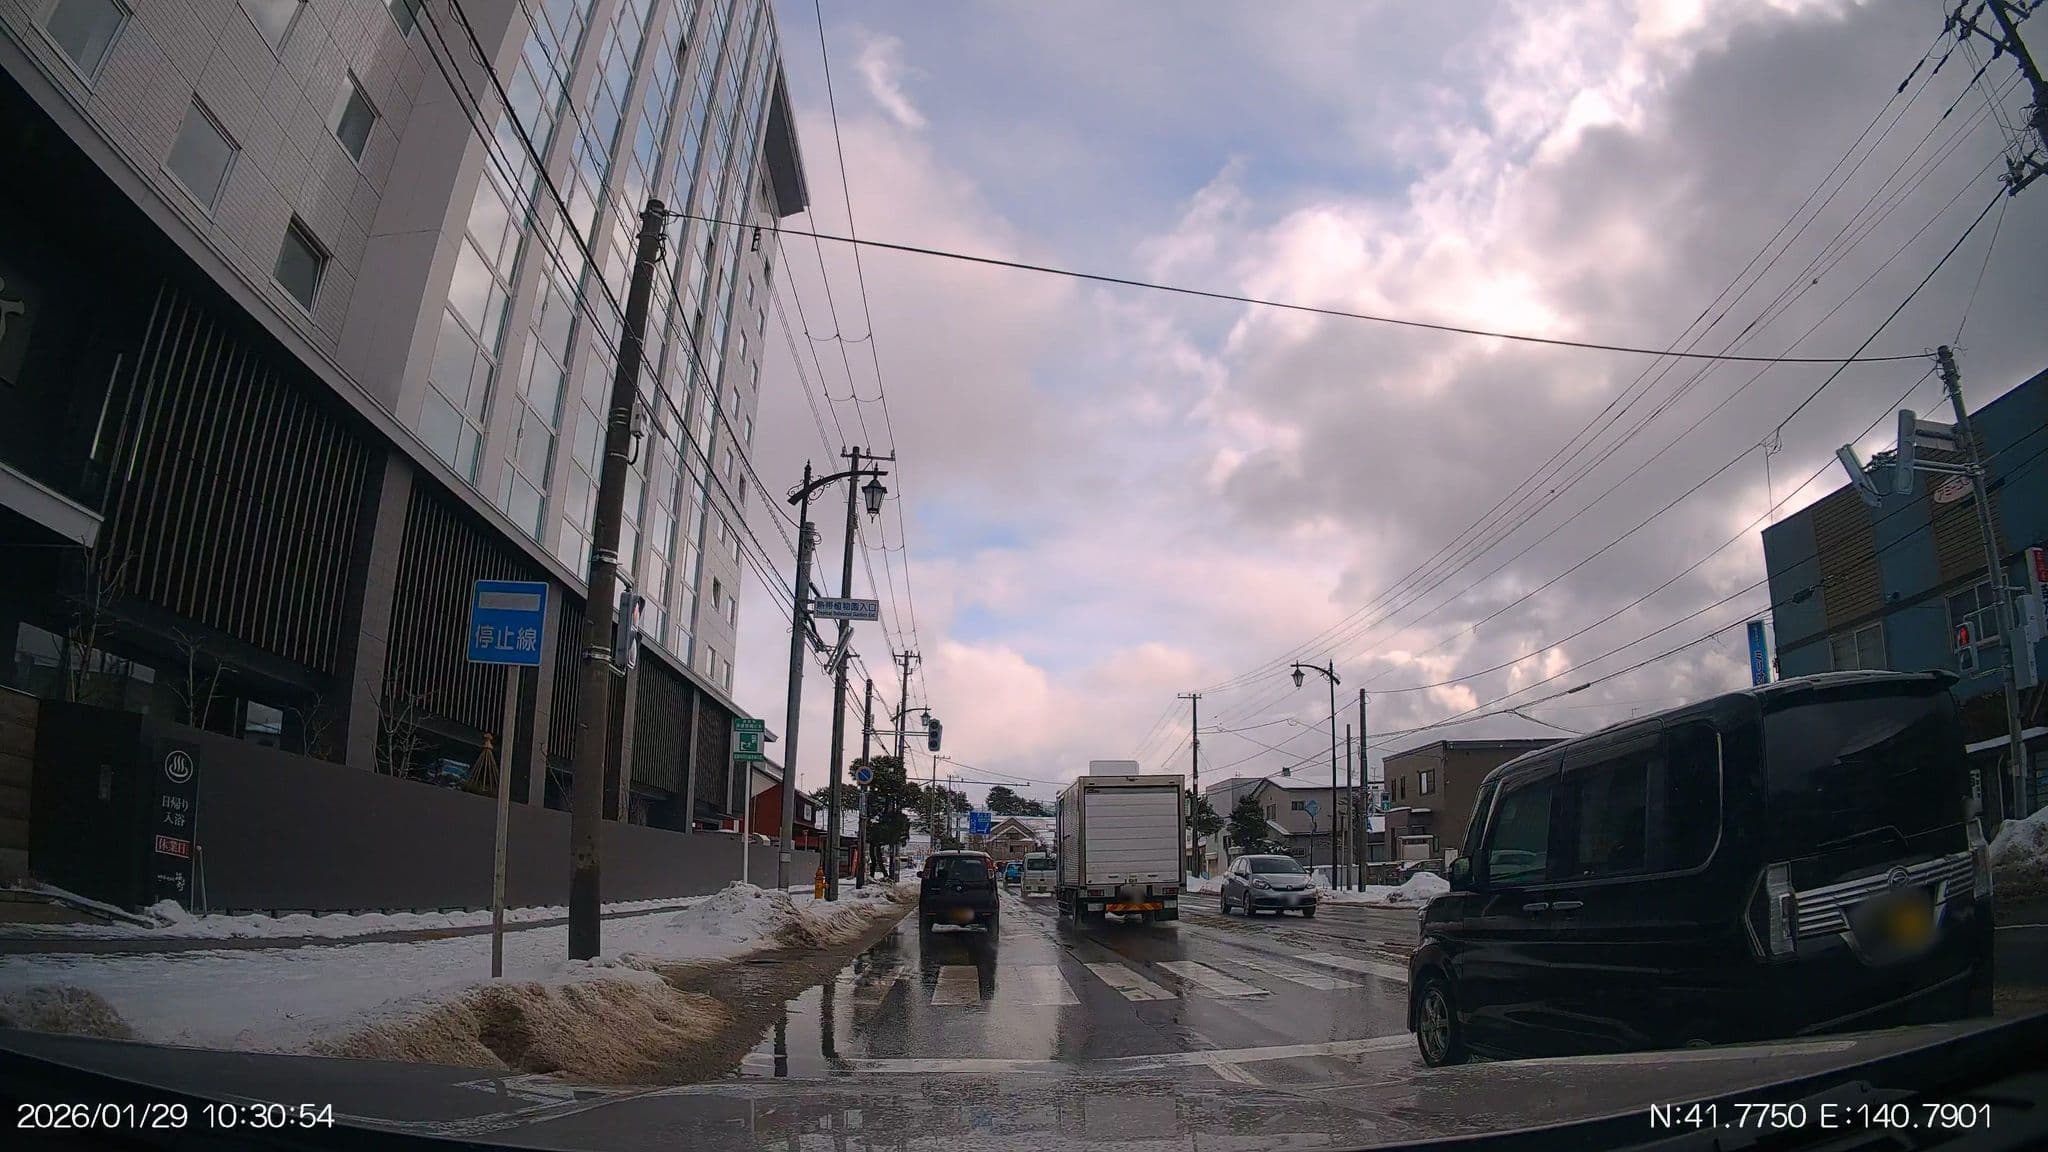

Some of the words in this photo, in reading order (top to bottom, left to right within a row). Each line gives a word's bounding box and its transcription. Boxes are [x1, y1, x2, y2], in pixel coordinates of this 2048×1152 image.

[475, 624, 537, 652] 停止線
[162, 795, 189, 812] 日帰り
[163, 812, 185, 827] 入浴
[158, 836, 186, 855] 休業日
